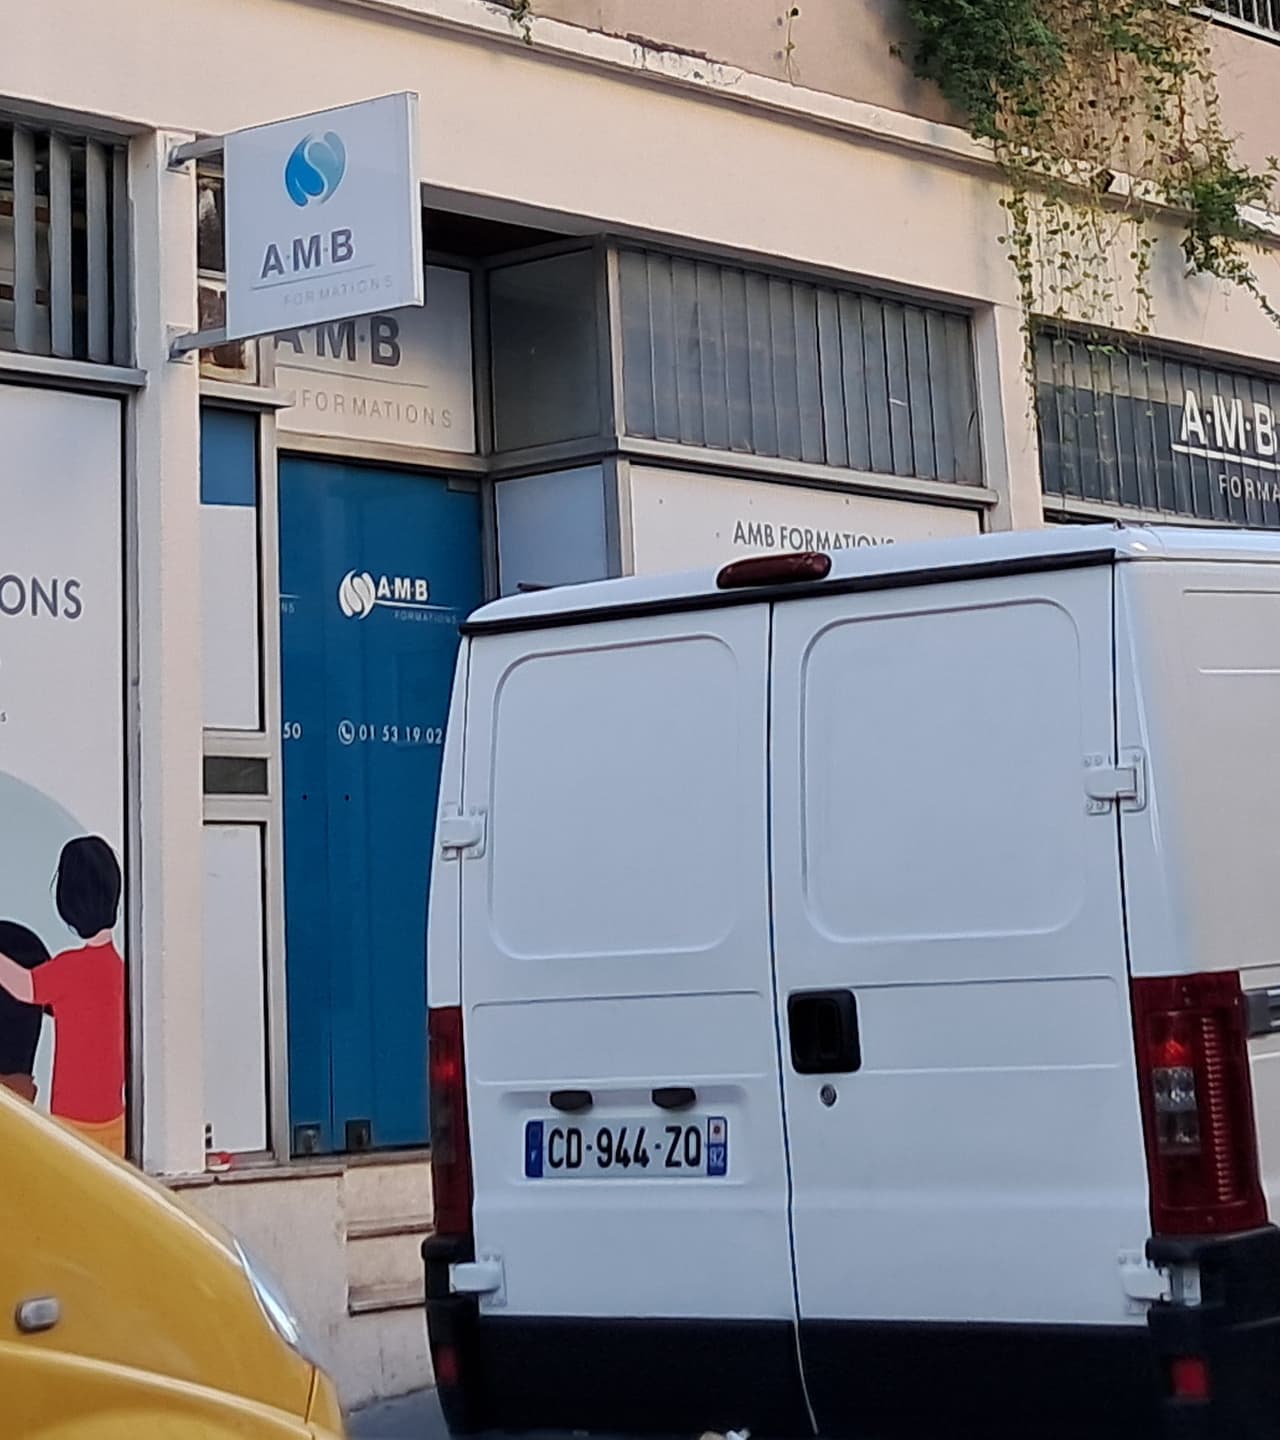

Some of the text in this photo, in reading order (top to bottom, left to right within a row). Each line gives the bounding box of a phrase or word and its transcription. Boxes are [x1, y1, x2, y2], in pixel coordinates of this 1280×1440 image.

[282, 274, 393, 306] FORMATIONS
[302, 389, 452, 428] FORMATIONS
[733, 520, 775, 547] AMB
[283, 721, 302, 739] 50
[358, 724, 443, 745] 01 53 19 02
